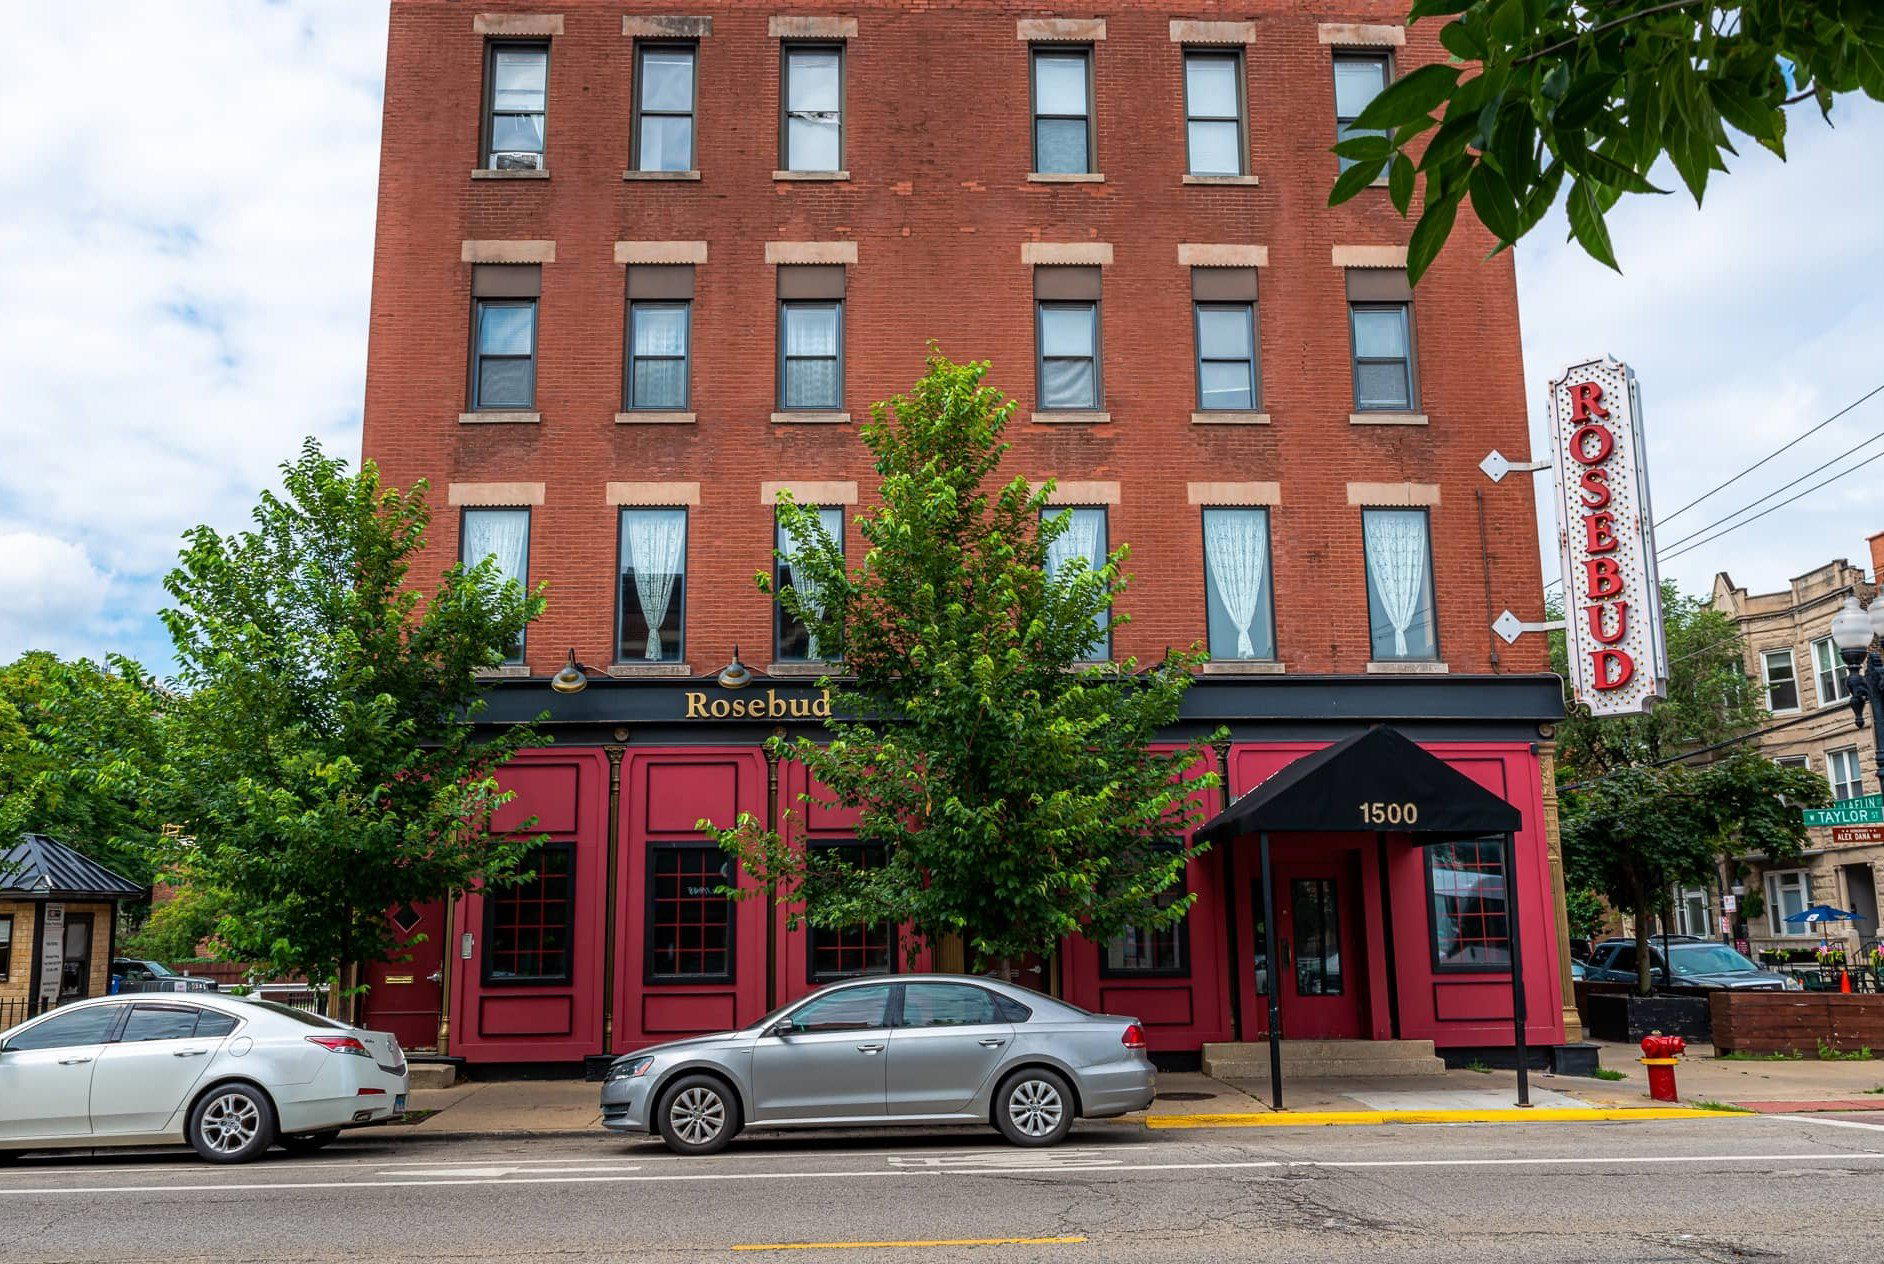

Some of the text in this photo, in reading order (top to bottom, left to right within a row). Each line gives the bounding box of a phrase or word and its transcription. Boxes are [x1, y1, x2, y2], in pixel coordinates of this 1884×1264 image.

[1566, 380, 1635, 691] ROSEBUD
[685, 688, 833, 718] Rosebud
[1359, 802, 1418, 824] 1500
[1817, 809, 1868, 824] TAYLOR
[1837, 833, 1853, 841] ALEX
